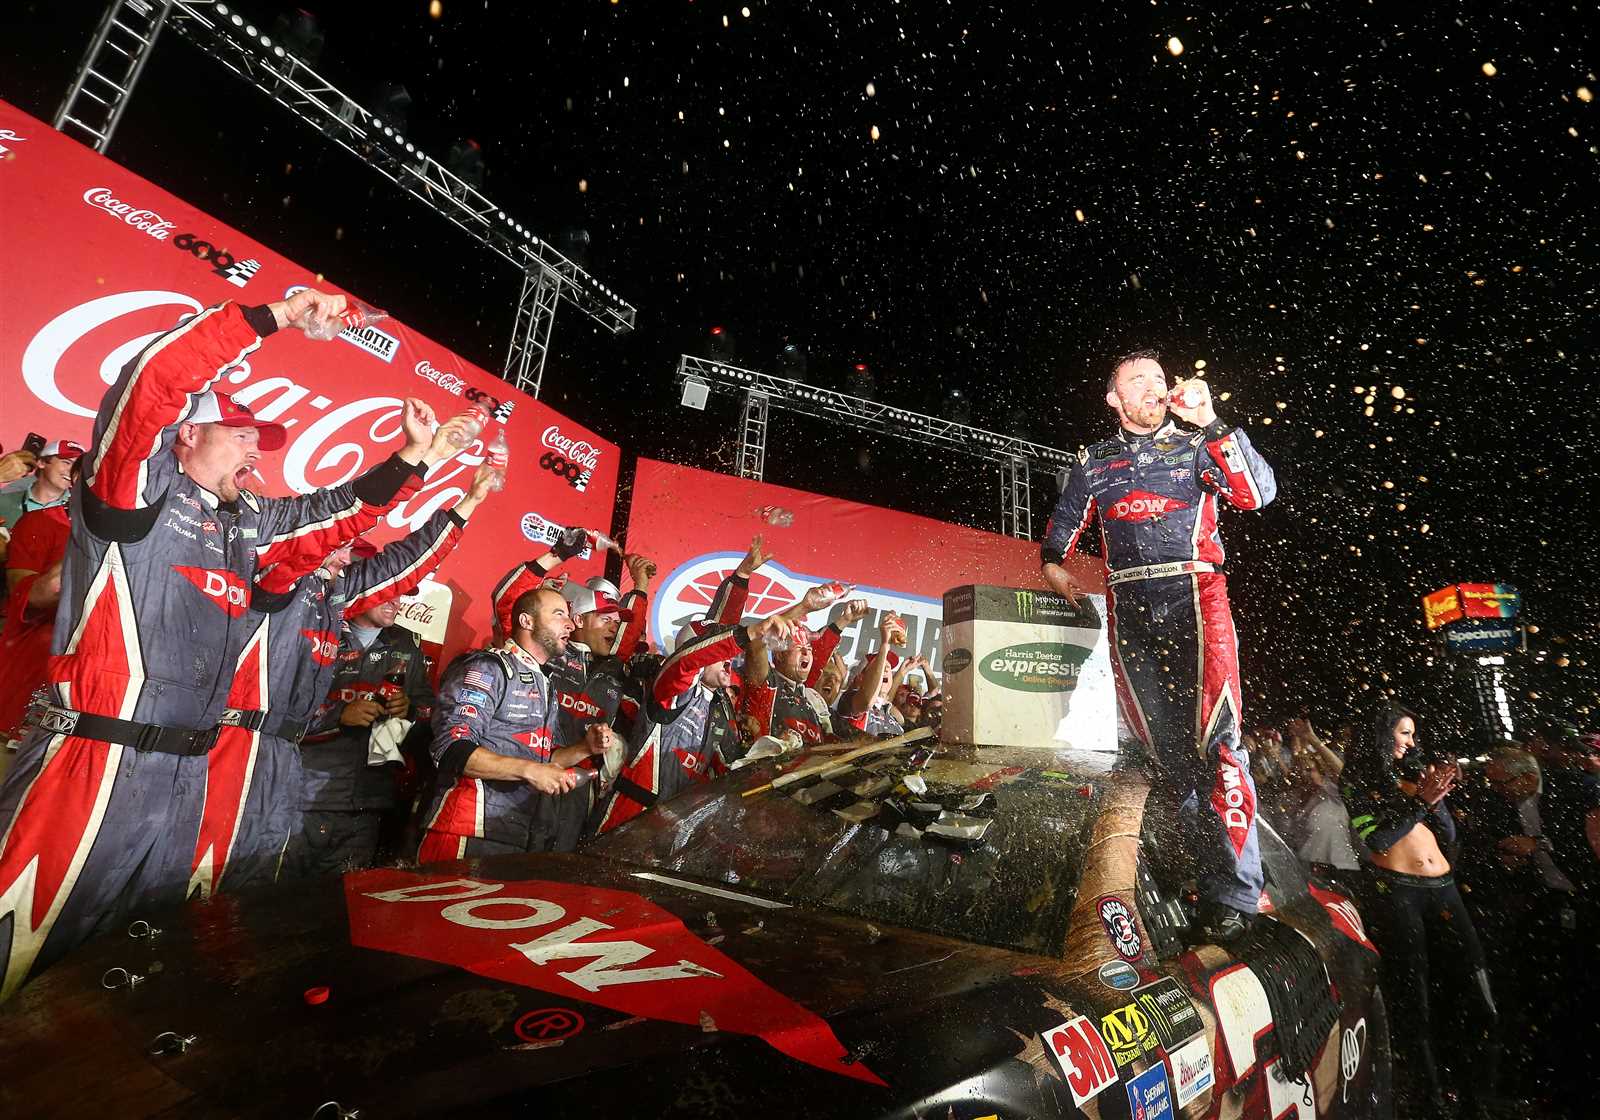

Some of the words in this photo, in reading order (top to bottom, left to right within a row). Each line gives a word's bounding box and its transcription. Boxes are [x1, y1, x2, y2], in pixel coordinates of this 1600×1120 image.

[83, 187, 176, 240] Coca-Cola
[173, 233, 235, 270] 600
[414, 360, 467, 397] Coca-Cola
[541, 425, 603, 470] Coca-Cola
[540, 452, 581, 481] 600
[1115, 499, 1169, 518] DOW
[1448, 629, 1512, 642] Spectrum
[1004, 648, 1034, 659] Harris
[1034, 650, 1063, 662] Teeter
[560, 694, 601, 718] DOW
[1224, 762, 1248, 830] DOW
[362, 878, 725, 993] DOW
[1052, 1019, 1116, 1098] 3M
